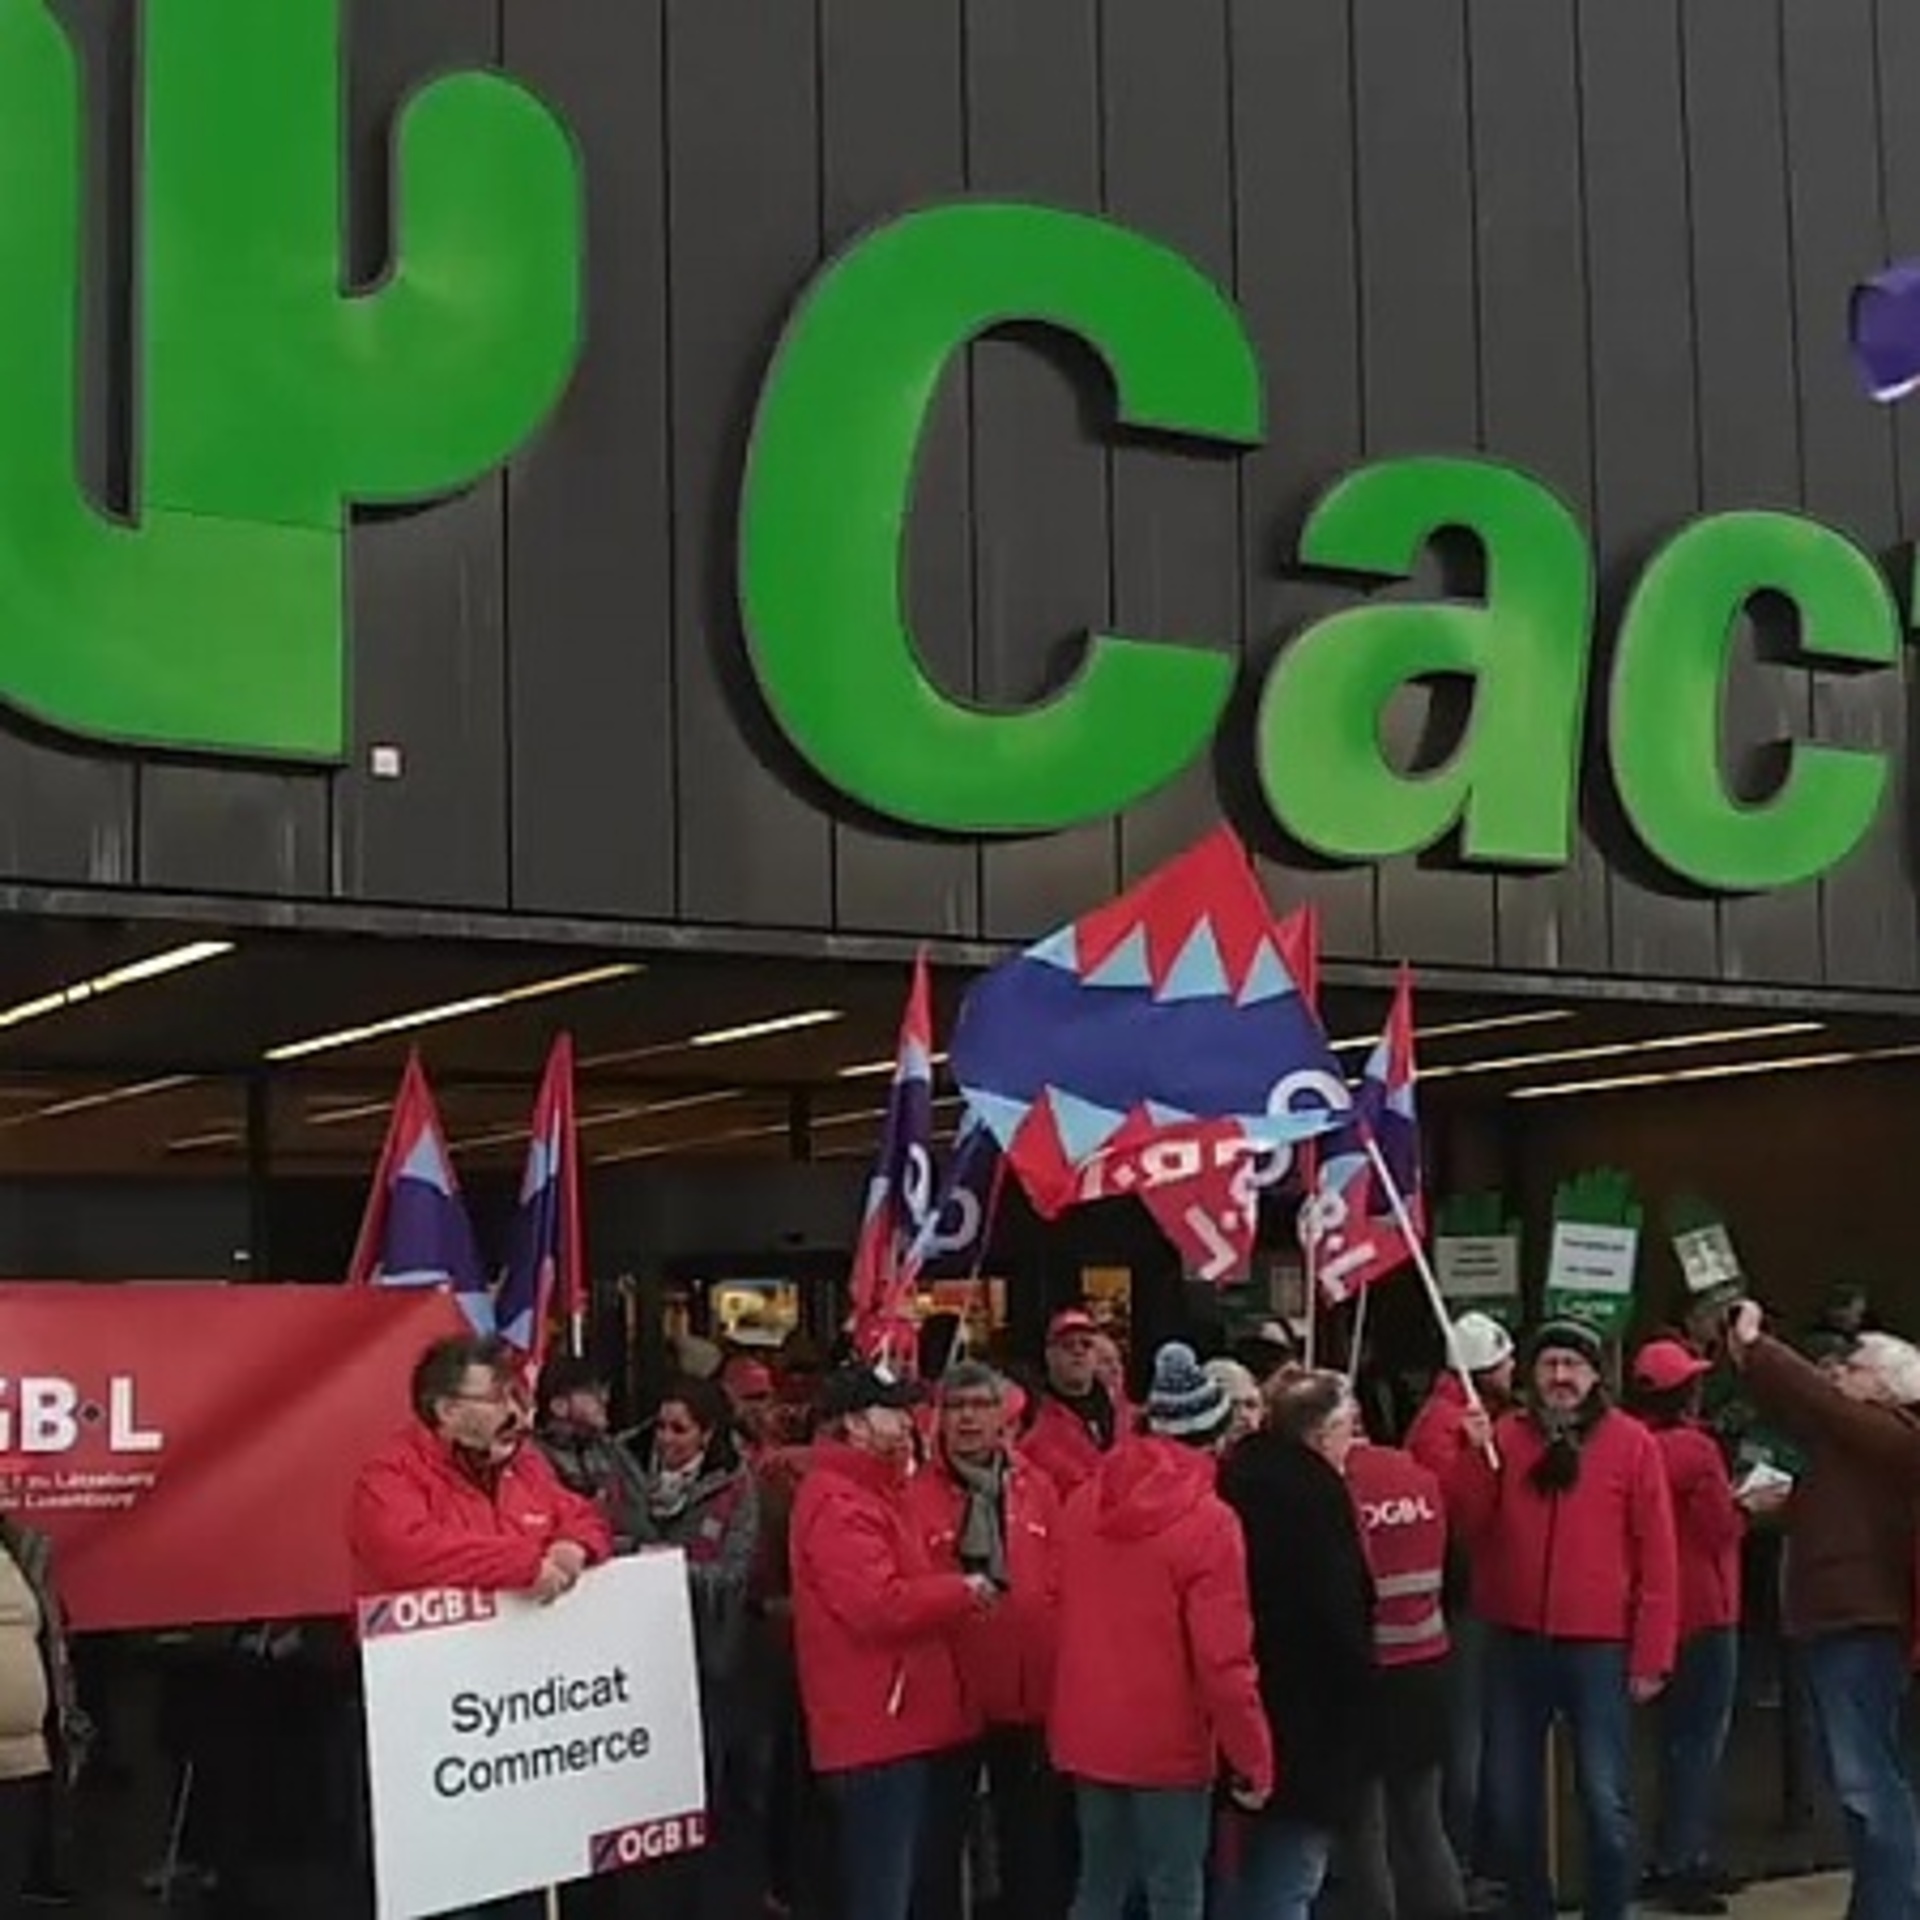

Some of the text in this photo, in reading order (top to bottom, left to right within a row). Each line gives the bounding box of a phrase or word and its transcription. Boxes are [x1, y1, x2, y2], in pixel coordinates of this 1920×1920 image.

[738, 203, 1920, 889] Cac
[0, 1377, 163, 1452] B·L
[451, 1664, 629, 1737] Syndicat
[433, 1726, 650, 1797] Commerce
